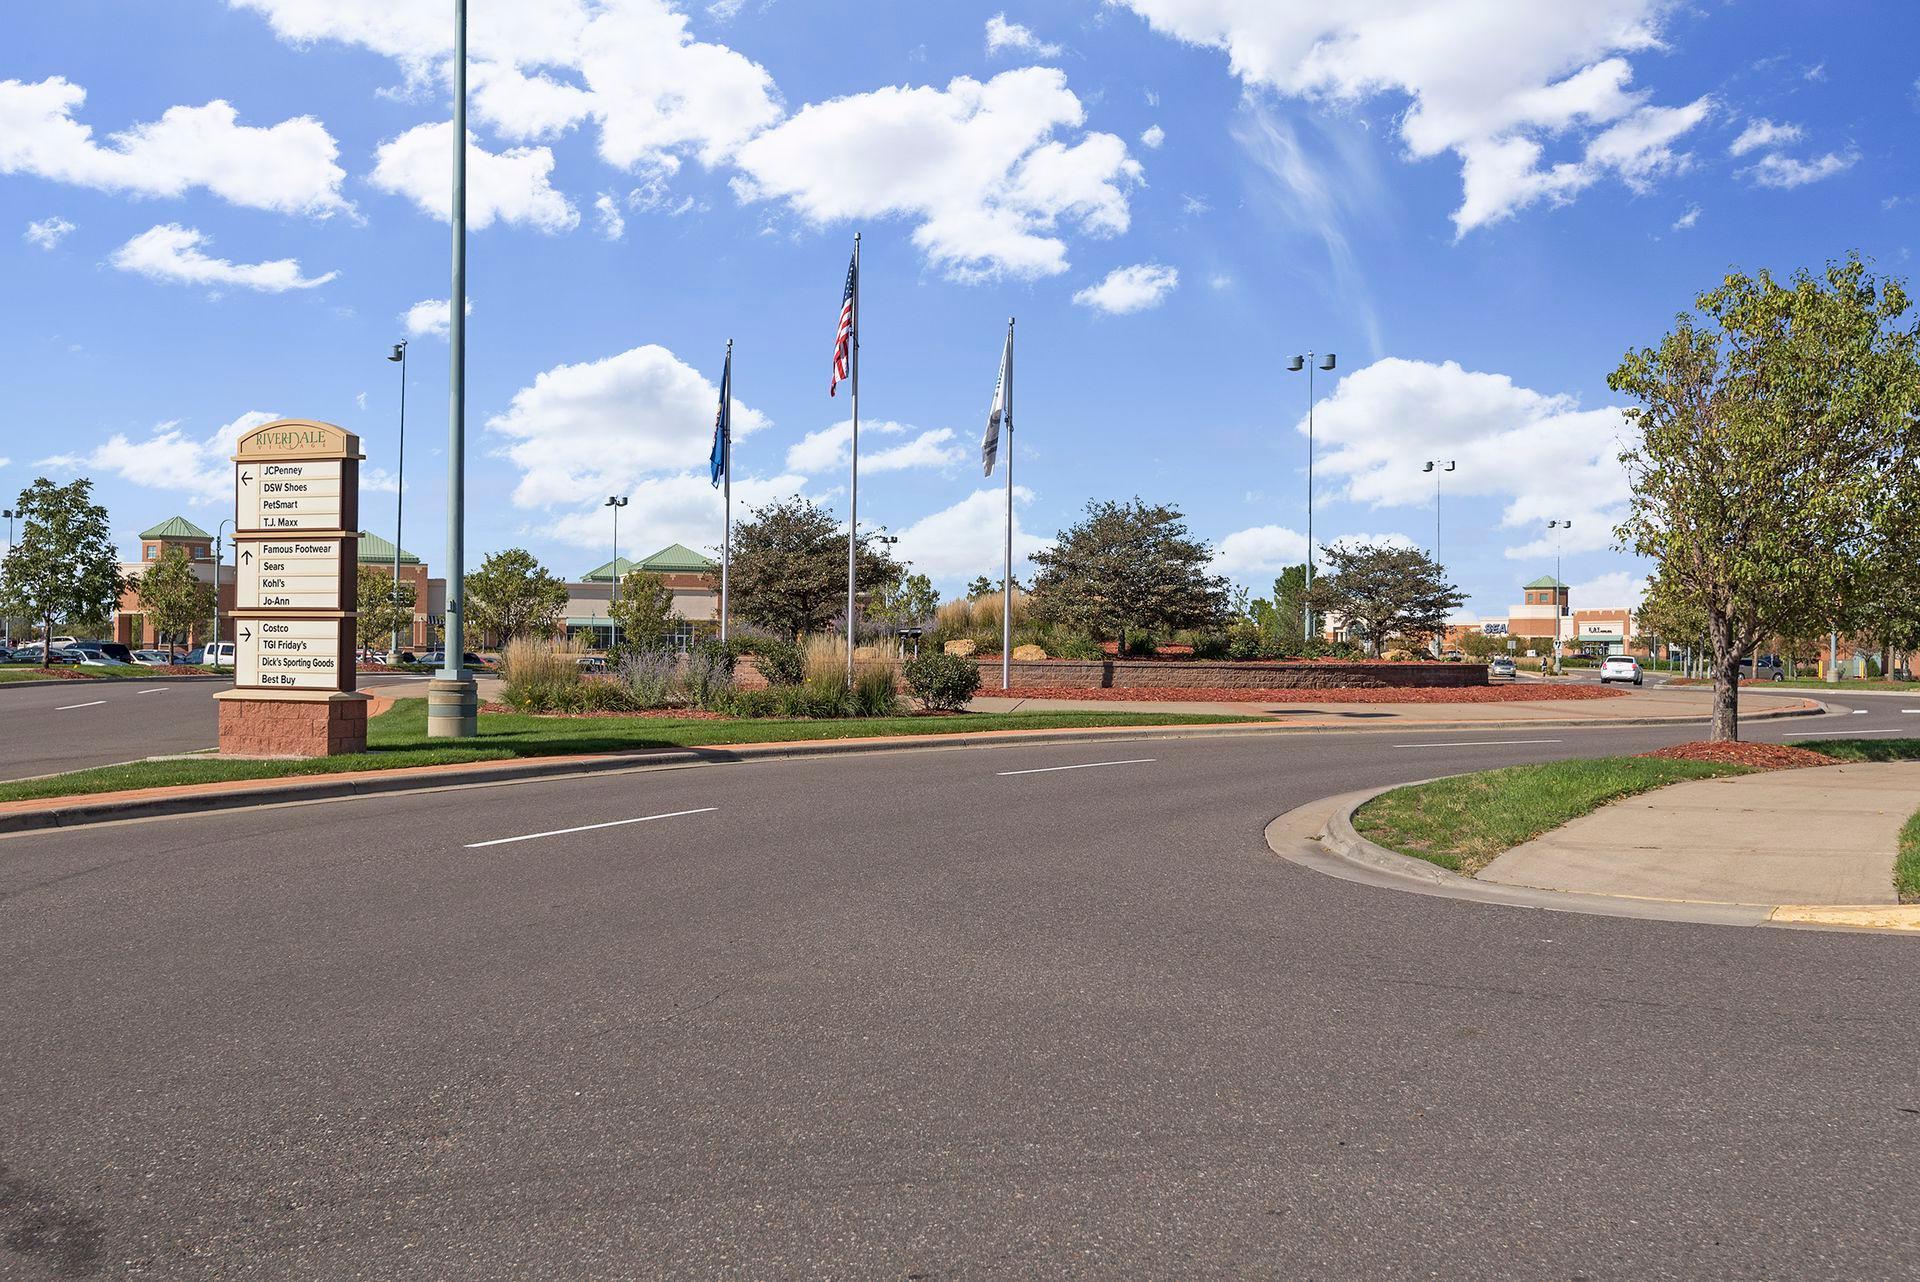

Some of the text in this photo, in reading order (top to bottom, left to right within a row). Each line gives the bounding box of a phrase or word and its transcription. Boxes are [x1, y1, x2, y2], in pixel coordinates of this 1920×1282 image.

[256, 431, 326, 450] RIVERDALE
[264, 466, 303, 476] JCPenney
[264, 483, 307, 492] DSW Shoes
[263, 500, 298, 509] PetSmart
[263, 518, 298, 527] T.J. Maxx
[263, 544, 331, 554] Famous Footwear
[263, 562, 285, 571] Sears
[262, 579, 285, 588] Kohl's
[263, 597, 290, 606] Jo-Ann
[263, 624, 289, 633] Costco
[1484, 623, 1509, 634] SEA
[263, 640, 307, 651] TGI Friday's
[262, 657, 335, 669] Dick's Sporting Goods
[261, 675, 296, 686] Best Buy
